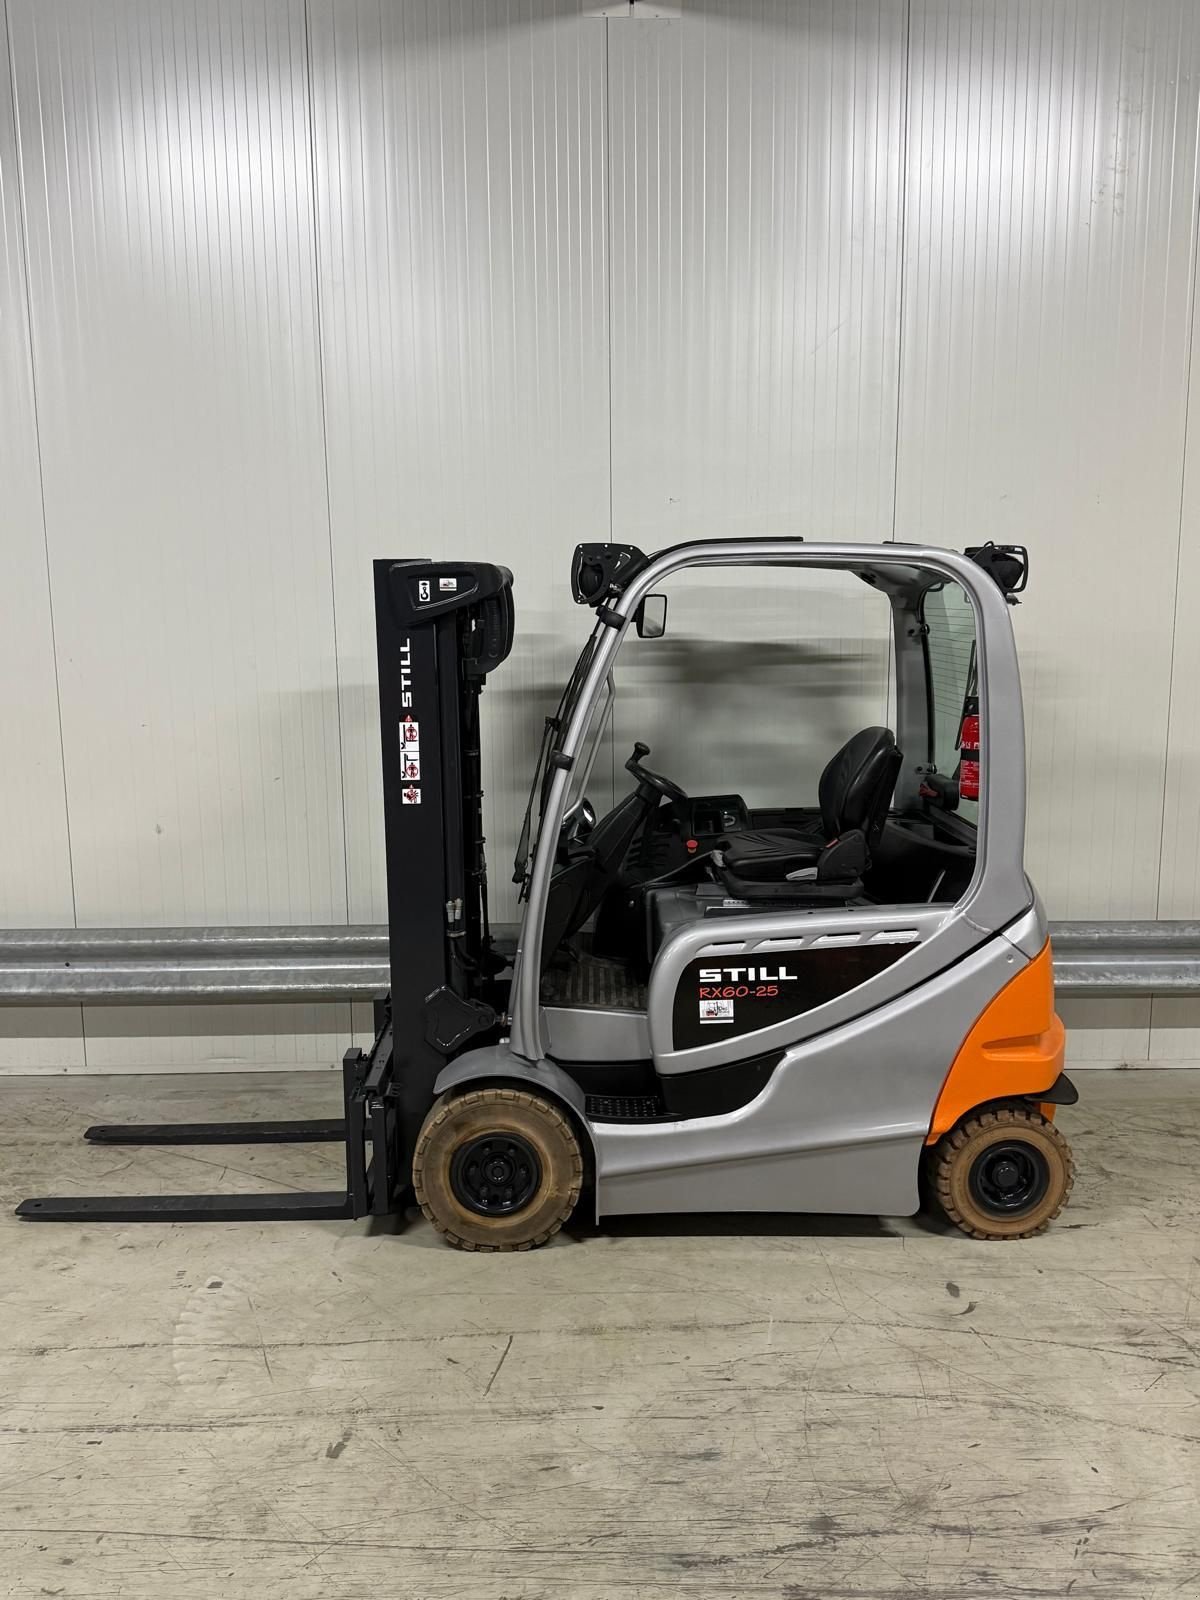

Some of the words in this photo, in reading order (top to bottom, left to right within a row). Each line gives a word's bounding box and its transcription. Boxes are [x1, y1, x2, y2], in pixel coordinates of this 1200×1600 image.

[400, 638, 412, 707] STILL
[700, 966, 798, 983] STILL
[700, 985, 779, 999] RX60-25
